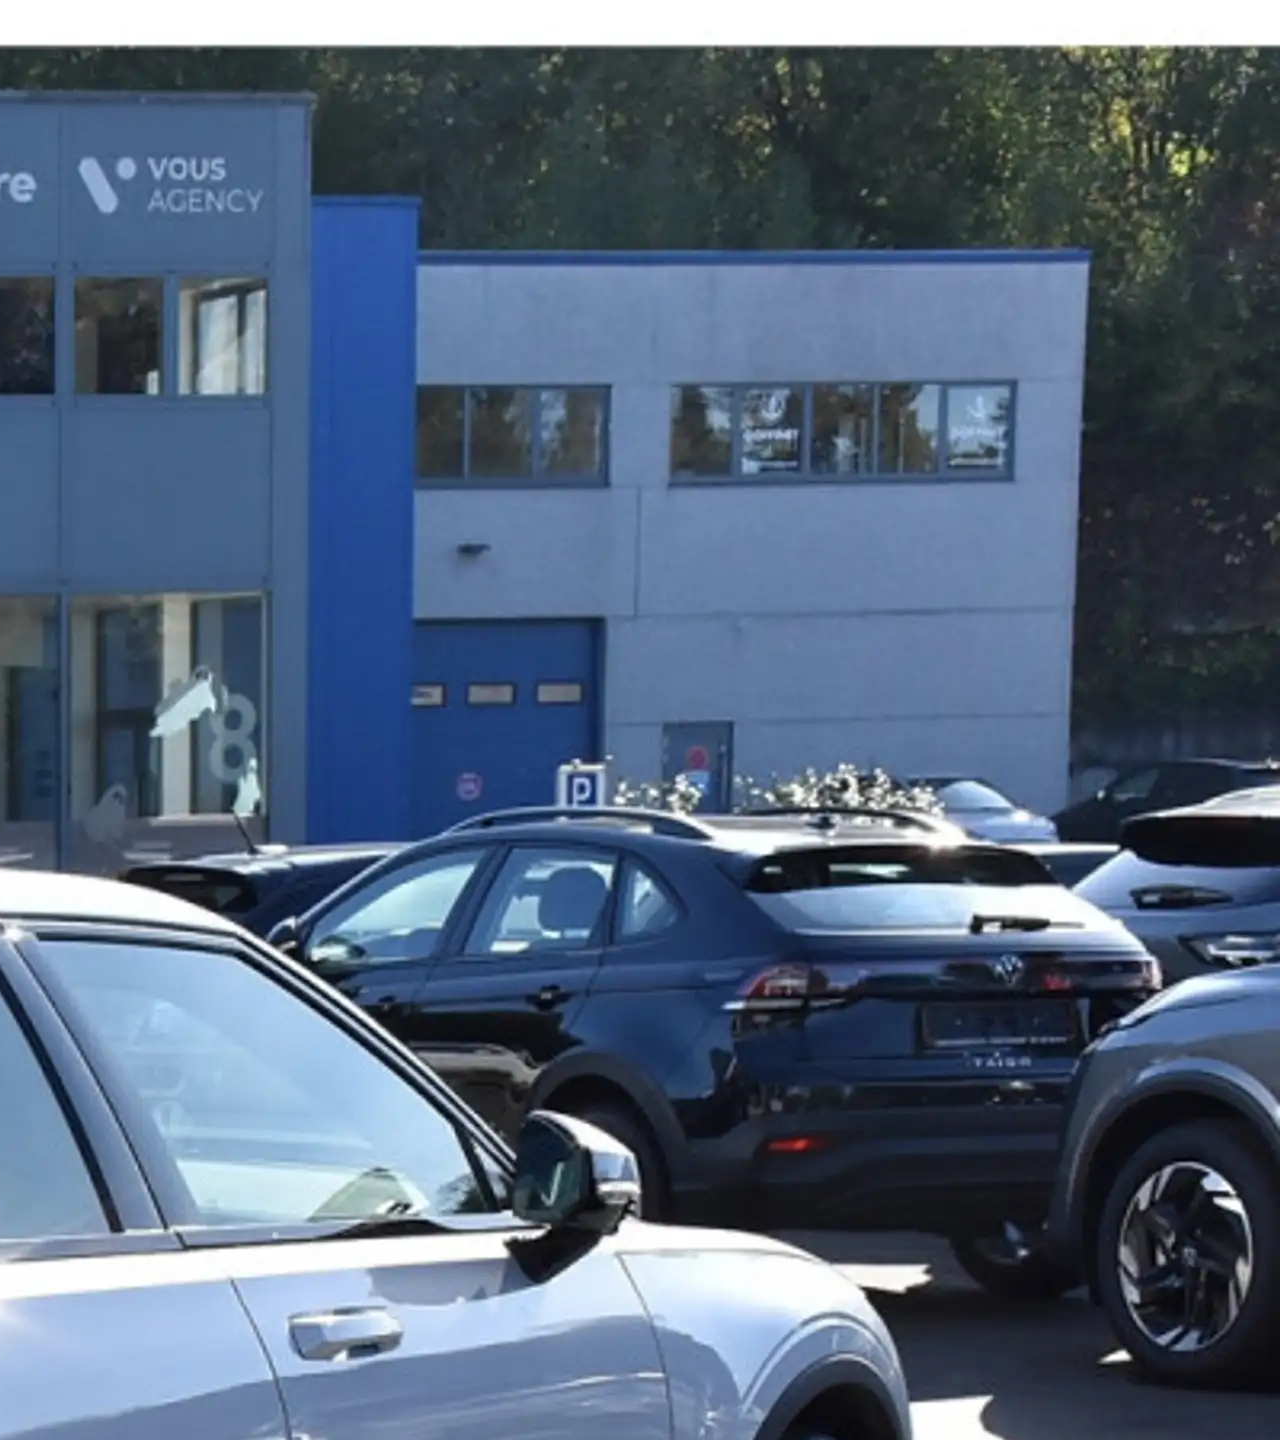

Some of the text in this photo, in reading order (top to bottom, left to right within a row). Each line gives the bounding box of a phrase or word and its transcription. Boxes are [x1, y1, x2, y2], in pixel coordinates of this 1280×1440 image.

[148, 156, 227, 181] VOUS
[147, 188, 264, 214] AGENCY
[572, 777, 592, 808] P
